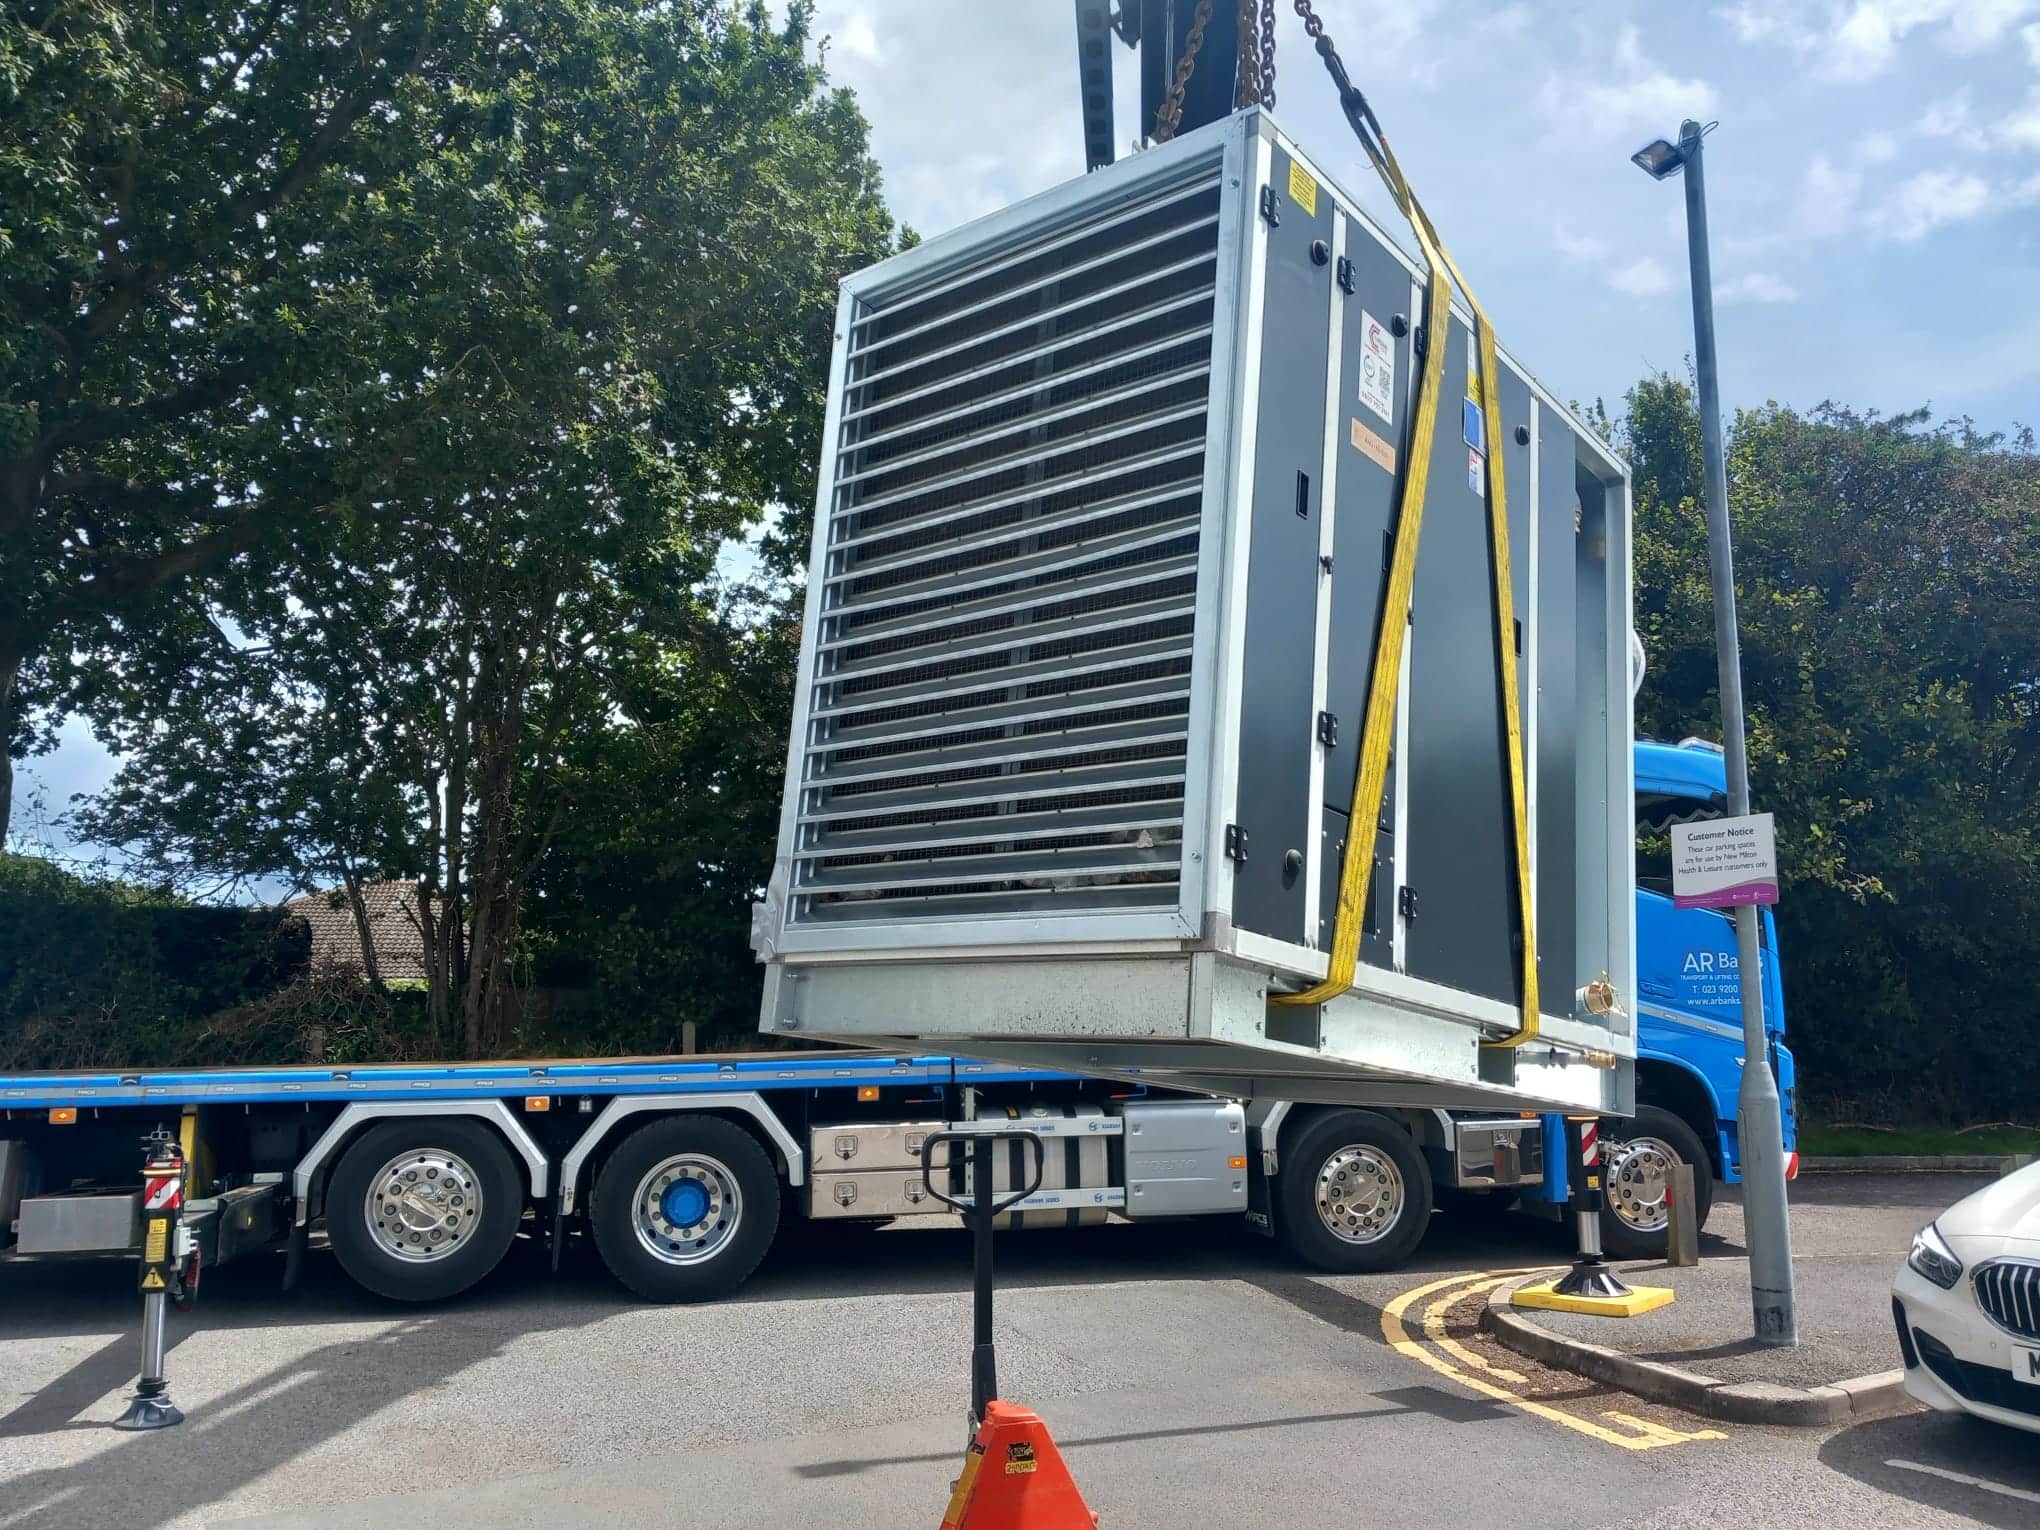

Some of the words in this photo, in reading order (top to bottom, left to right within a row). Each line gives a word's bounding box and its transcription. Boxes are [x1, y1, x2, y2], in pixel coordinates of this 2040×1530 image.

[1687, 830, 1725, 842] Customer
[1727, 827, 1754, 837] Notice
[1687, 846, 1703, 854] These
[1715, 843, 1736, 852] parking
[1738, 842, 1756, 851] spaces
[1695, 855, 1703, 863] for
[1715, 854, 1722, 863] by
[1724, 853, 1738, 861] New
[1739, 851, 1758, 859] Milton
[1678, 865, 1697, 875] Health
[1704, 863, 1723, 873] Leisure
[1724, 861, 1754, 872] customers
[1755, 859, 1768, 870] only
[1683, 952, 1714, 973] AR
[1719, 952, 1739, 969] Ba
[1702, 985, 1717, 993] 023
[1719, 984, 1738, 993] 9200
[1687, 996, 1741, 1007] www.arbanks
